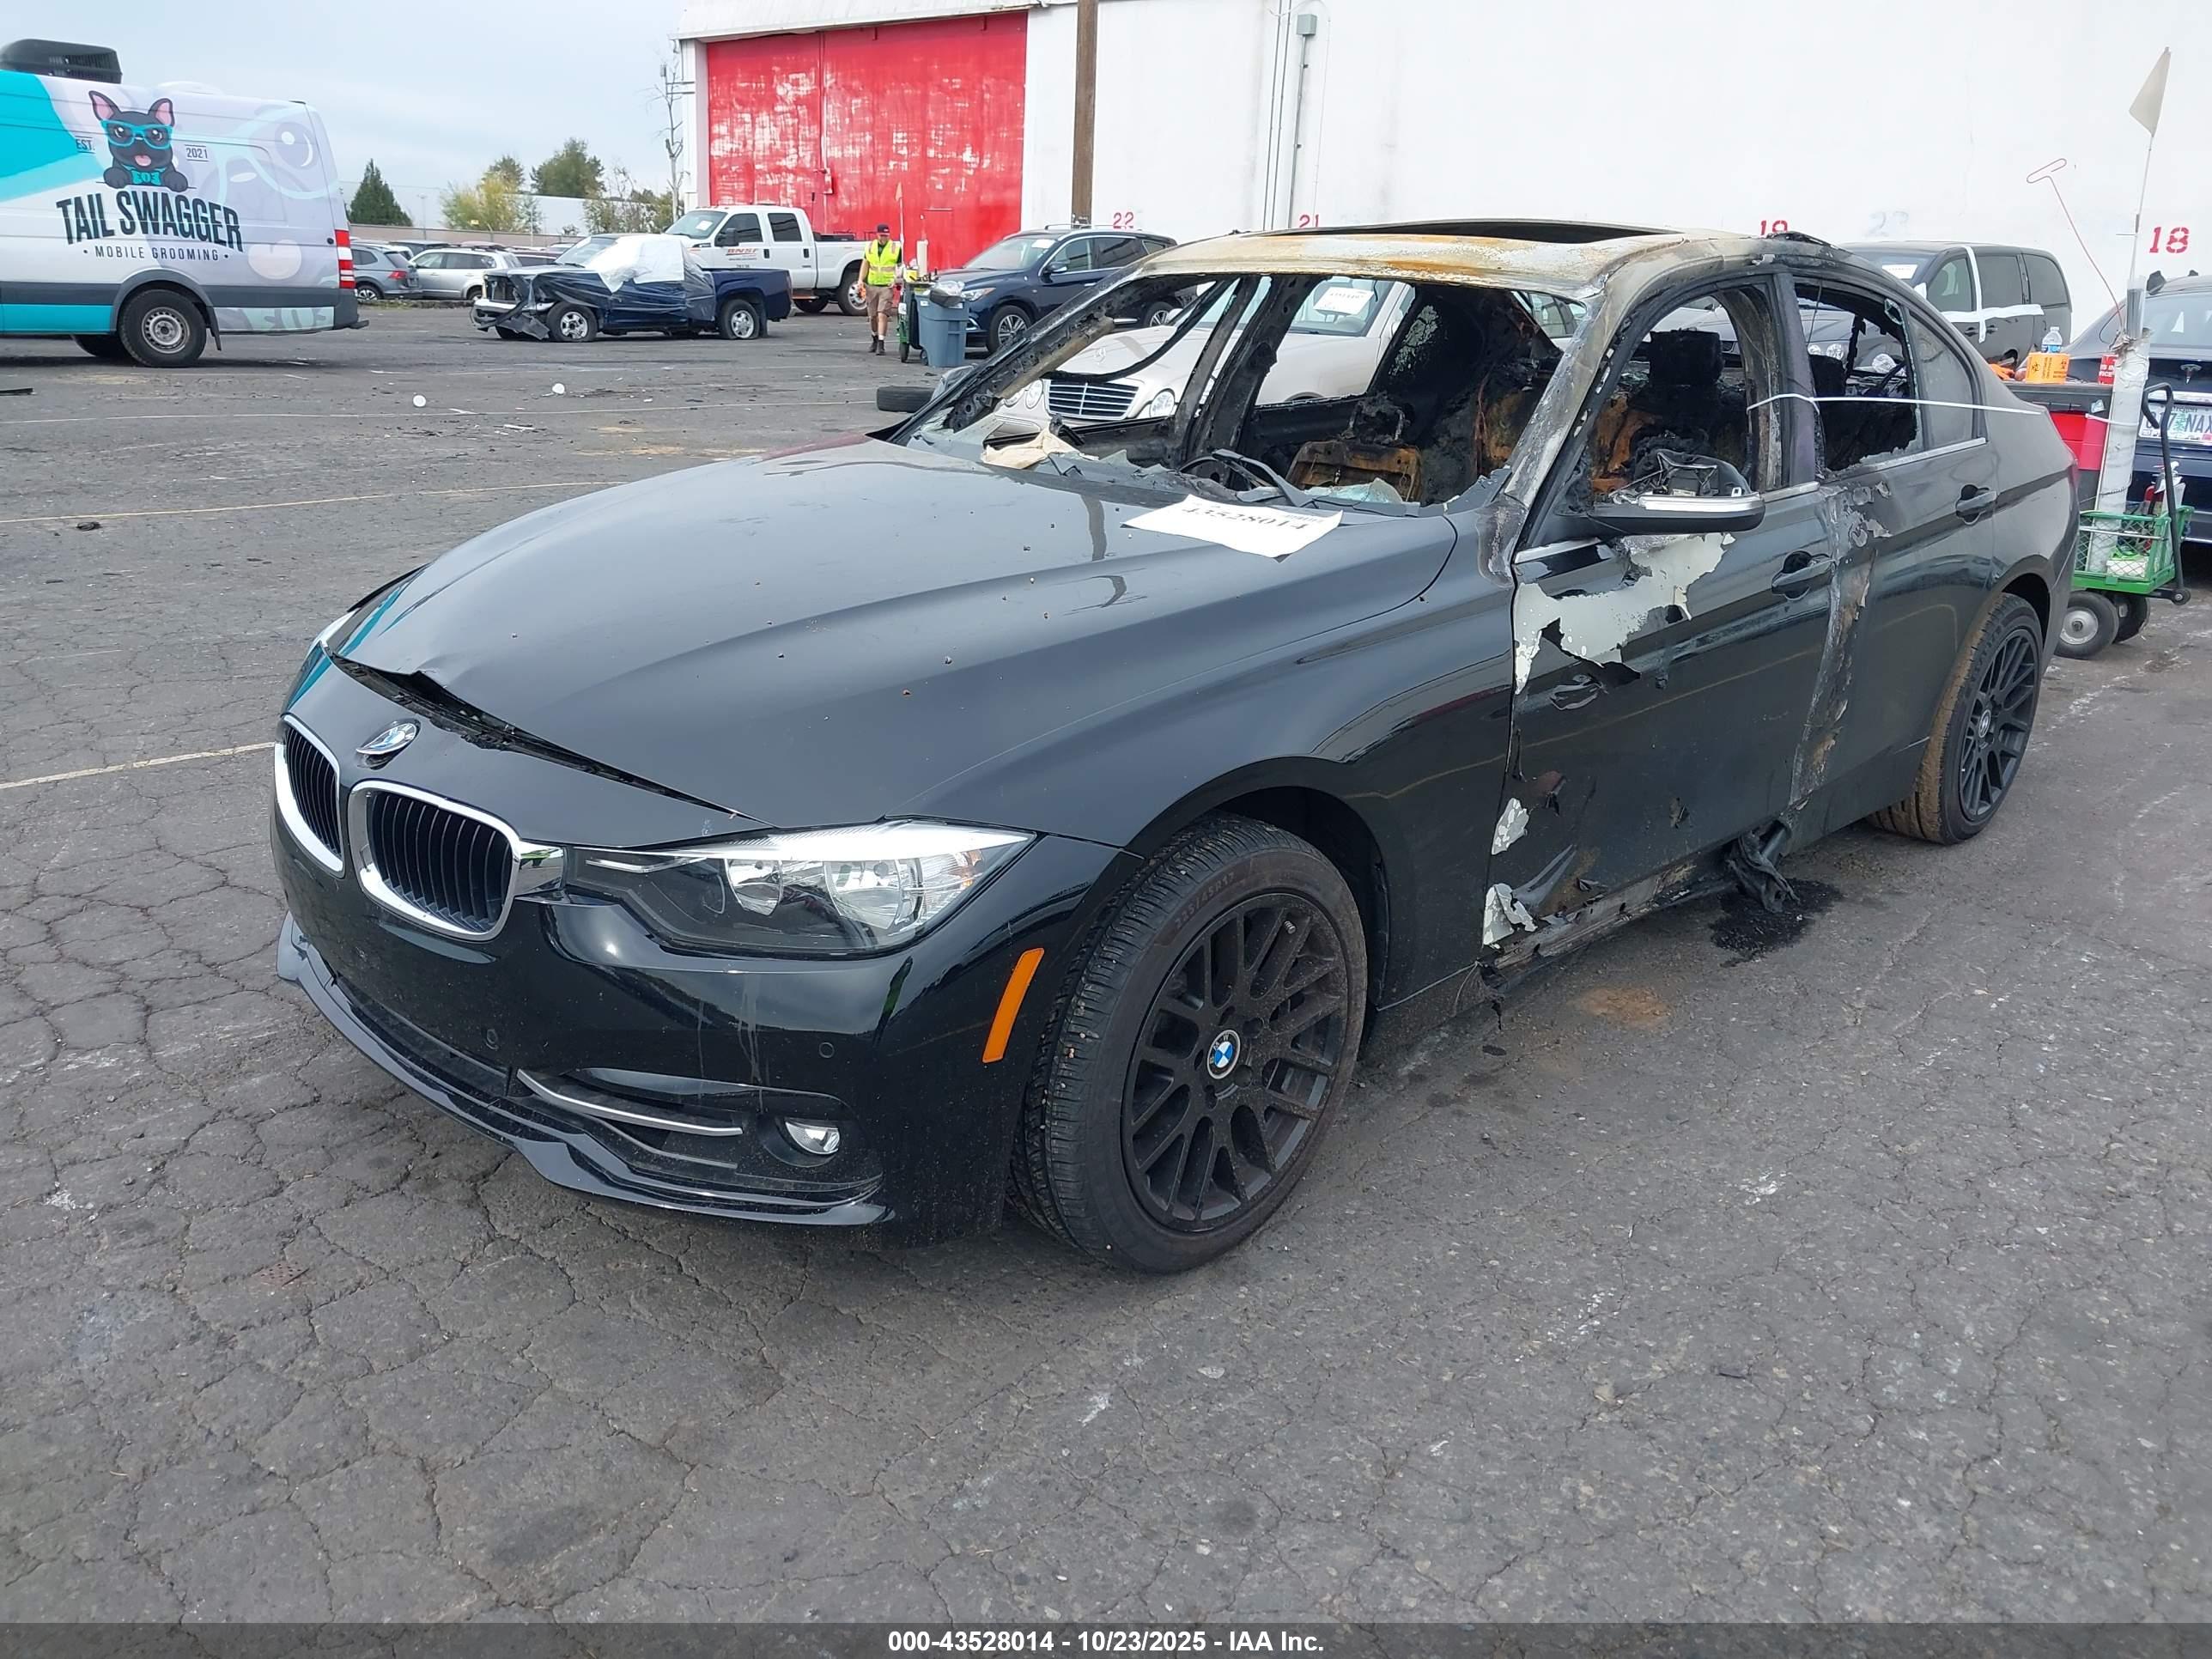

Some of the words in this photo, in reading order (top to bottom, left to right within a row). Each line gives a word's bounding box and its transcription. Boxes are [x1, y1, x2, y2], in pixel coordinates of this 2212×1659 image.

[76, 138, 95, 150] EST.
[185, 147, 208, 159] 2021
[56, 192, 114, 245] TAIL
[116, 190, 243, 252] SWAGGER
[1112, 211, 1134, 229] 22
[1298, 214, 1320, 229] 21
[2149, 226, 2190, 253] 18
[94, 246, 145, 259] MOBILE
[152, 246, 219, 261] GROOMING
